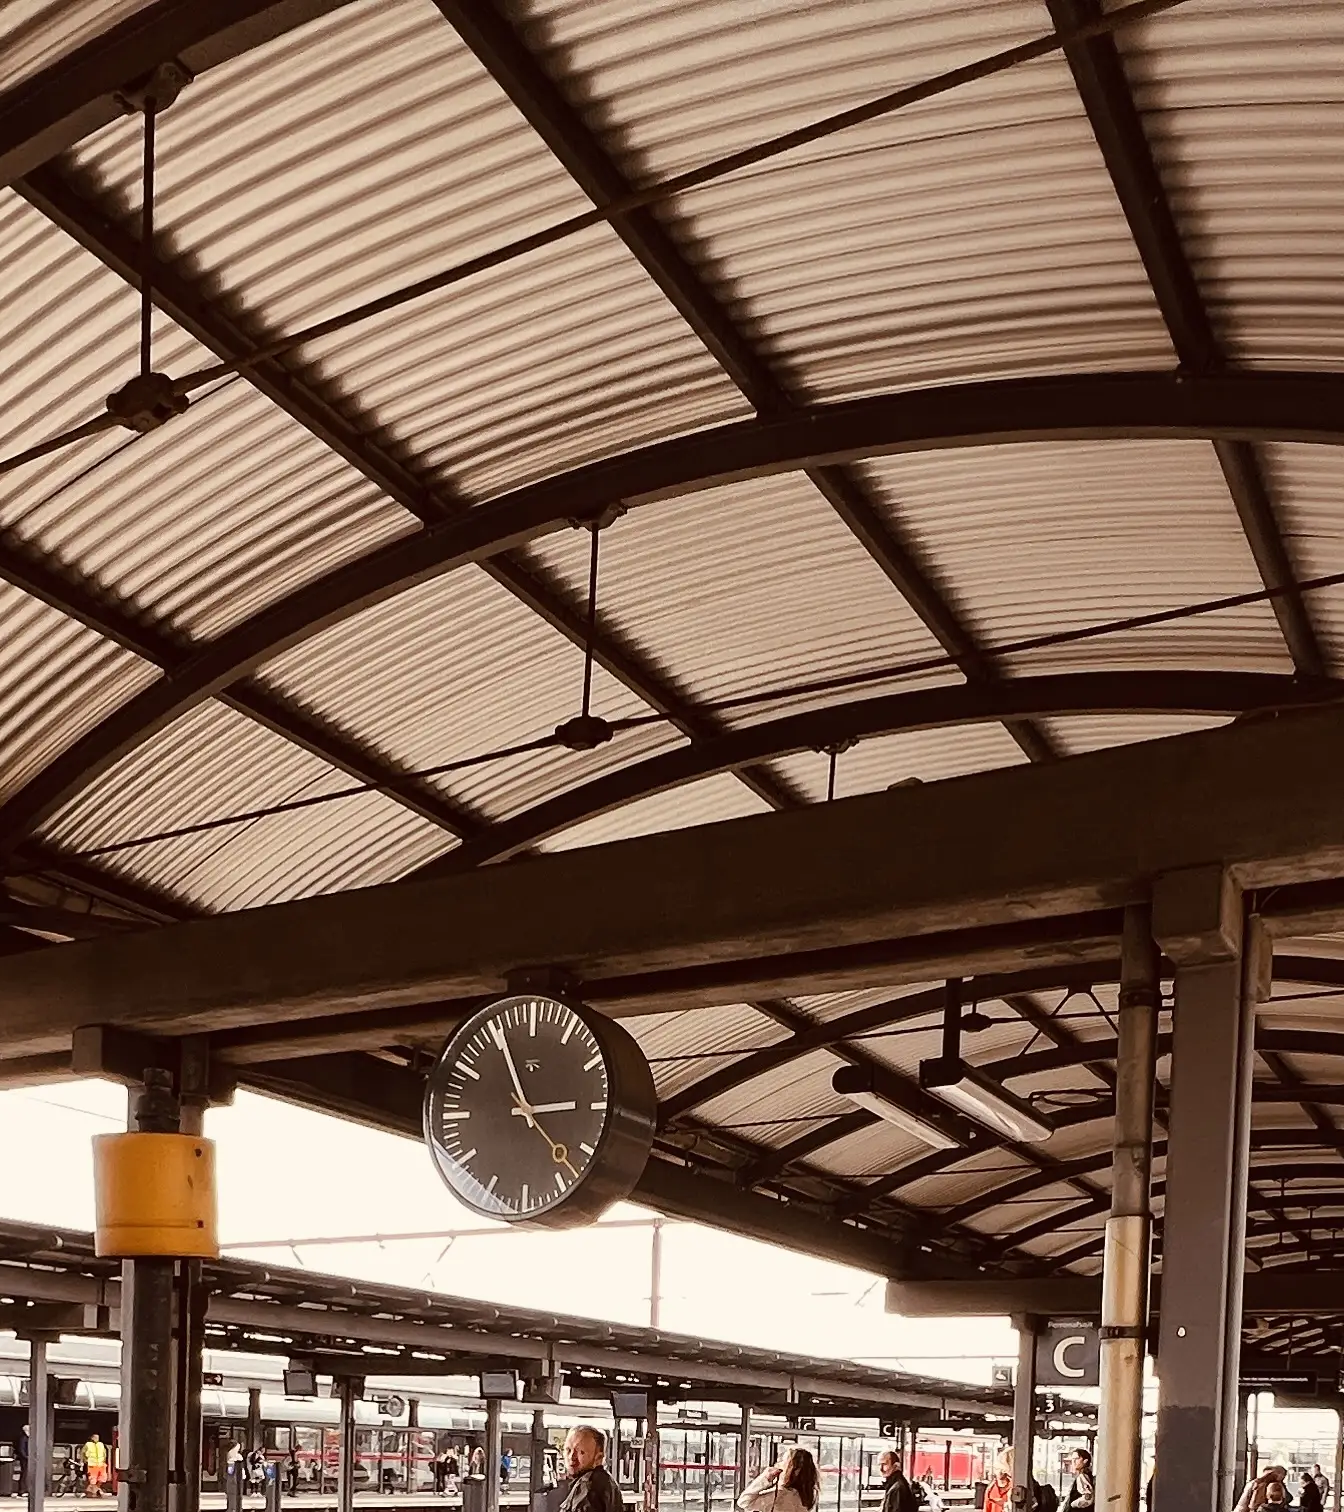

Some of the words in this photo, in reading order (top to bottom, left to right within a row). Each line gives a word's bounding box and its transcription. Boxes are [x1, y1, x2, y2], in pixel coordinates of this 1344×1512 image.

[1053, 1336, 1086, 1378] C
[1045, 1400, 1055, 1412] 3
[882, 1424, 892, 1436] C
